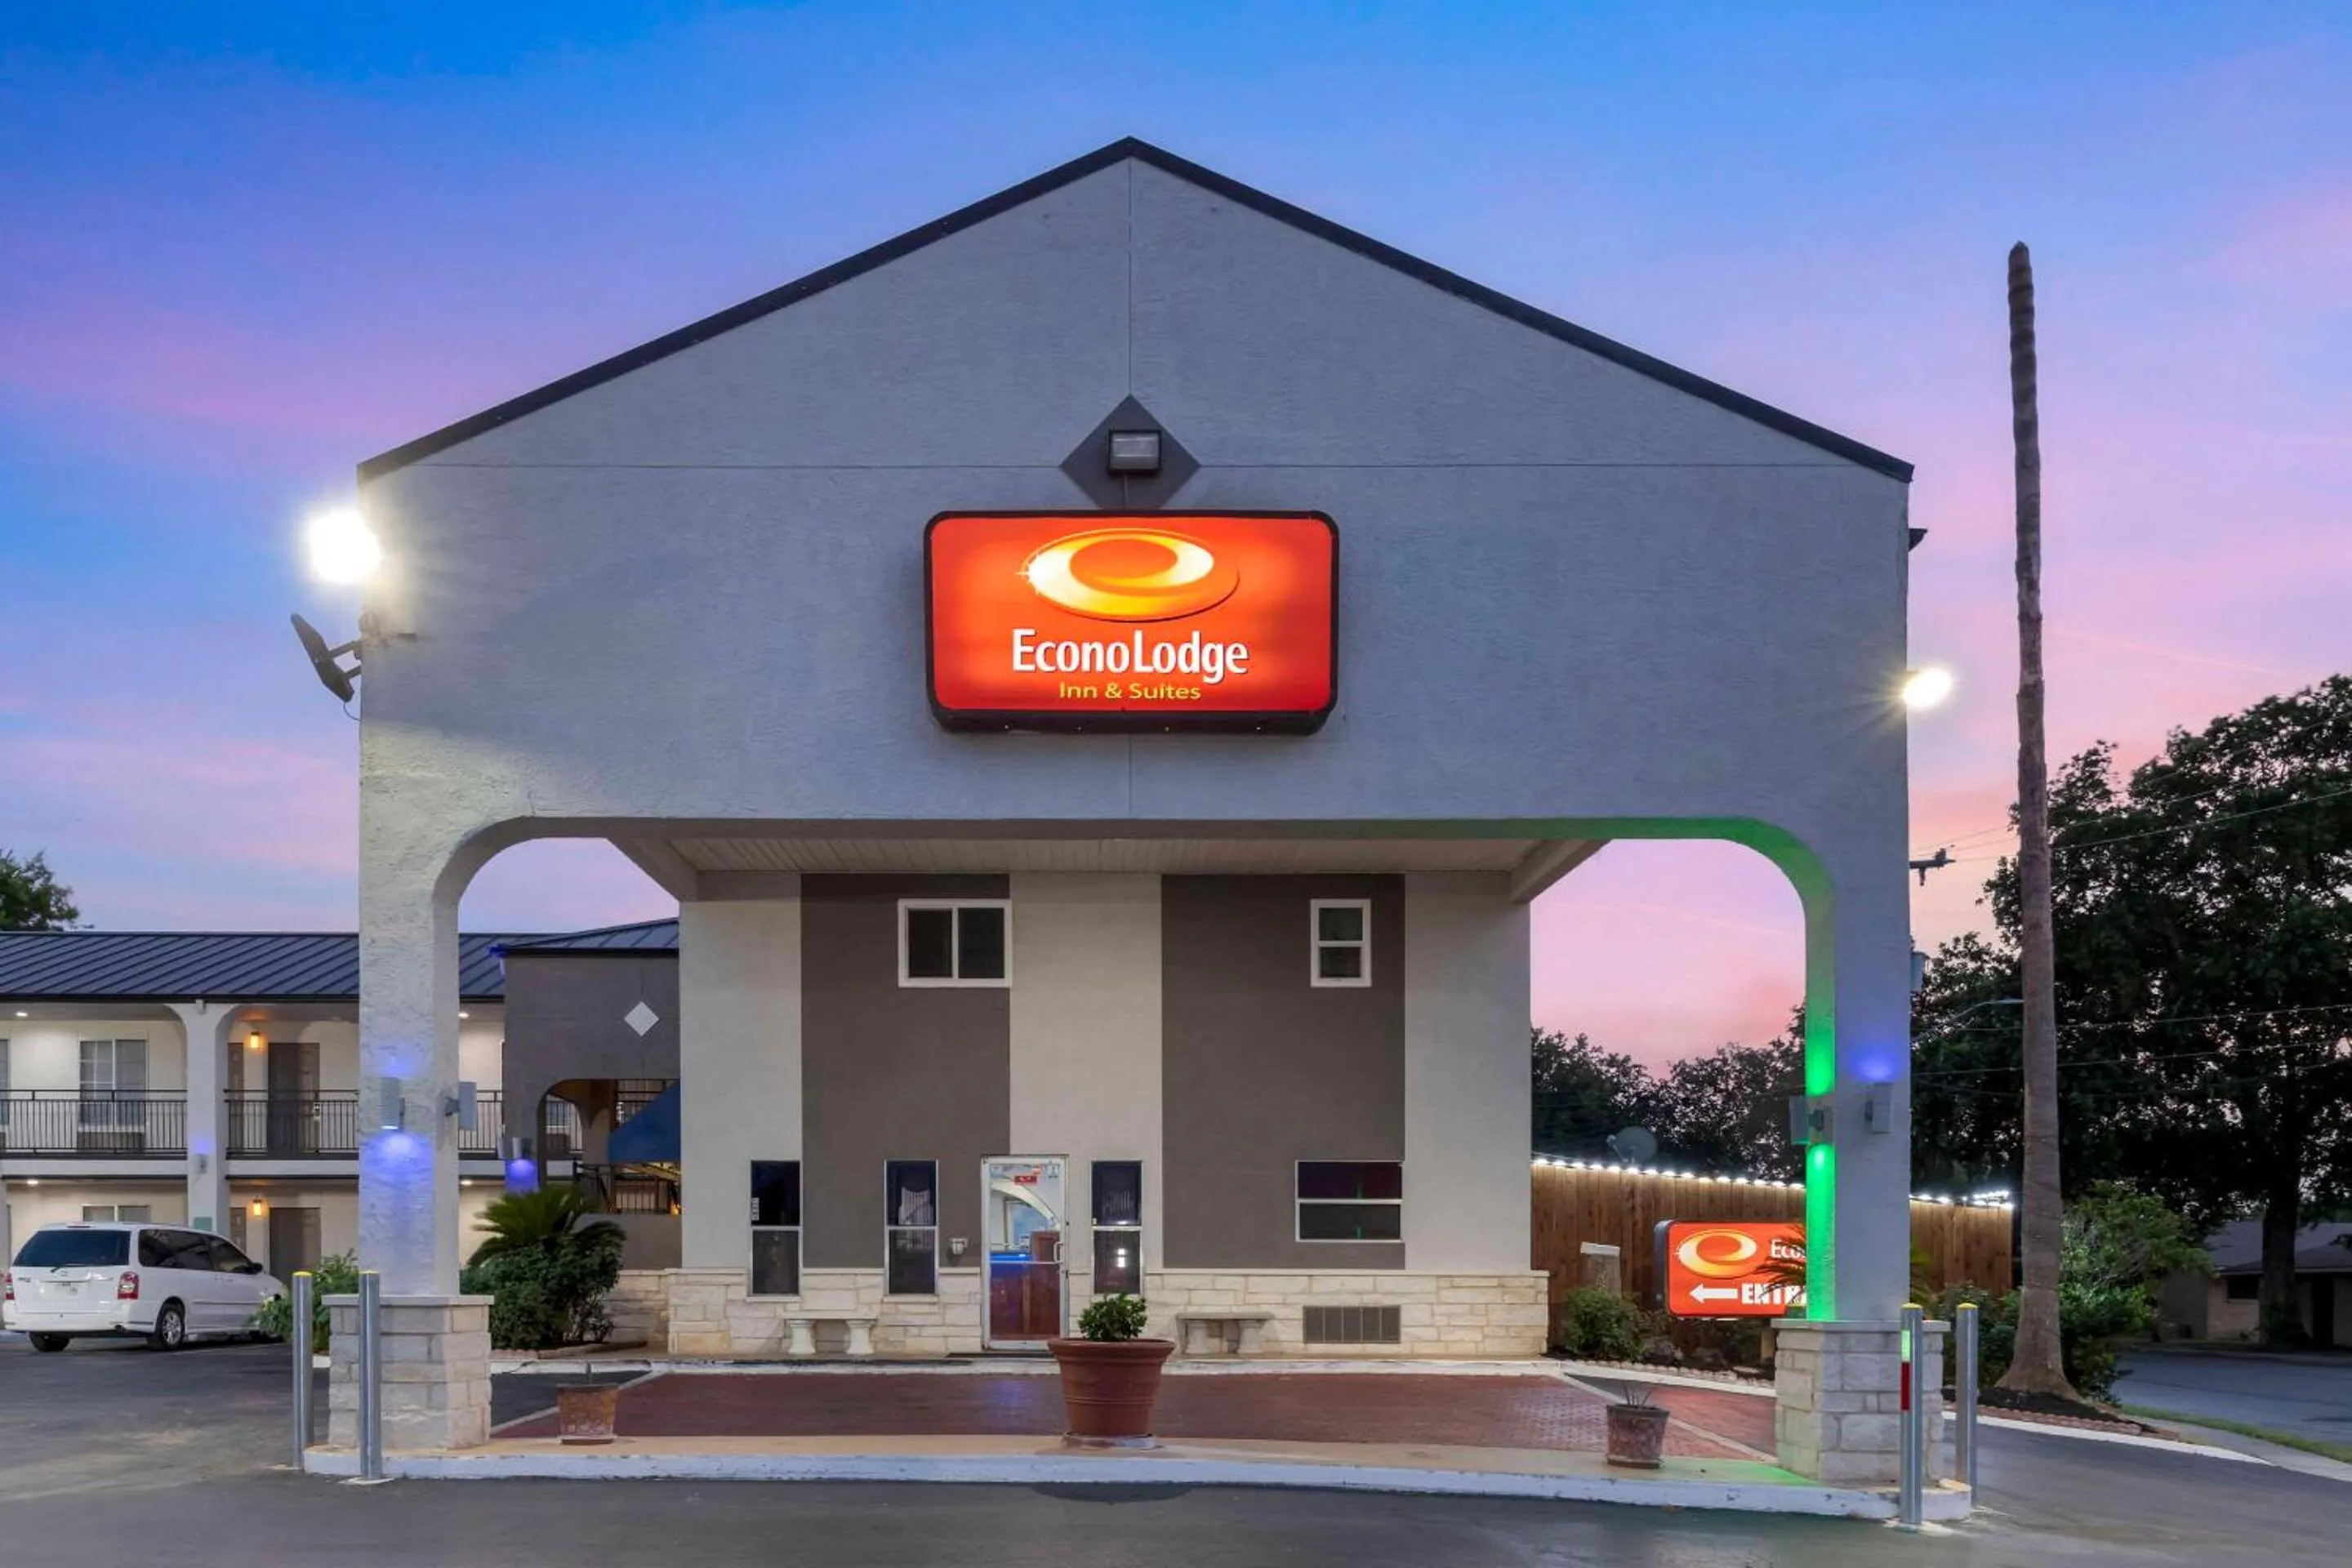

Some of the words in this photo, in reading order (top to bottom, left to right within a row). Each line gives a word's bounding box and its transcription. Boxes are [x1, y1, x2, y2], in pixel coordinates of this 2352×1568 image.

[1012, 628, 1249, 684] EconoLodge
[1059, 683, 1098, 699] Inn
[1104, 683, 1123, 699] &
[1129, 683, 1201, 700] Suites
